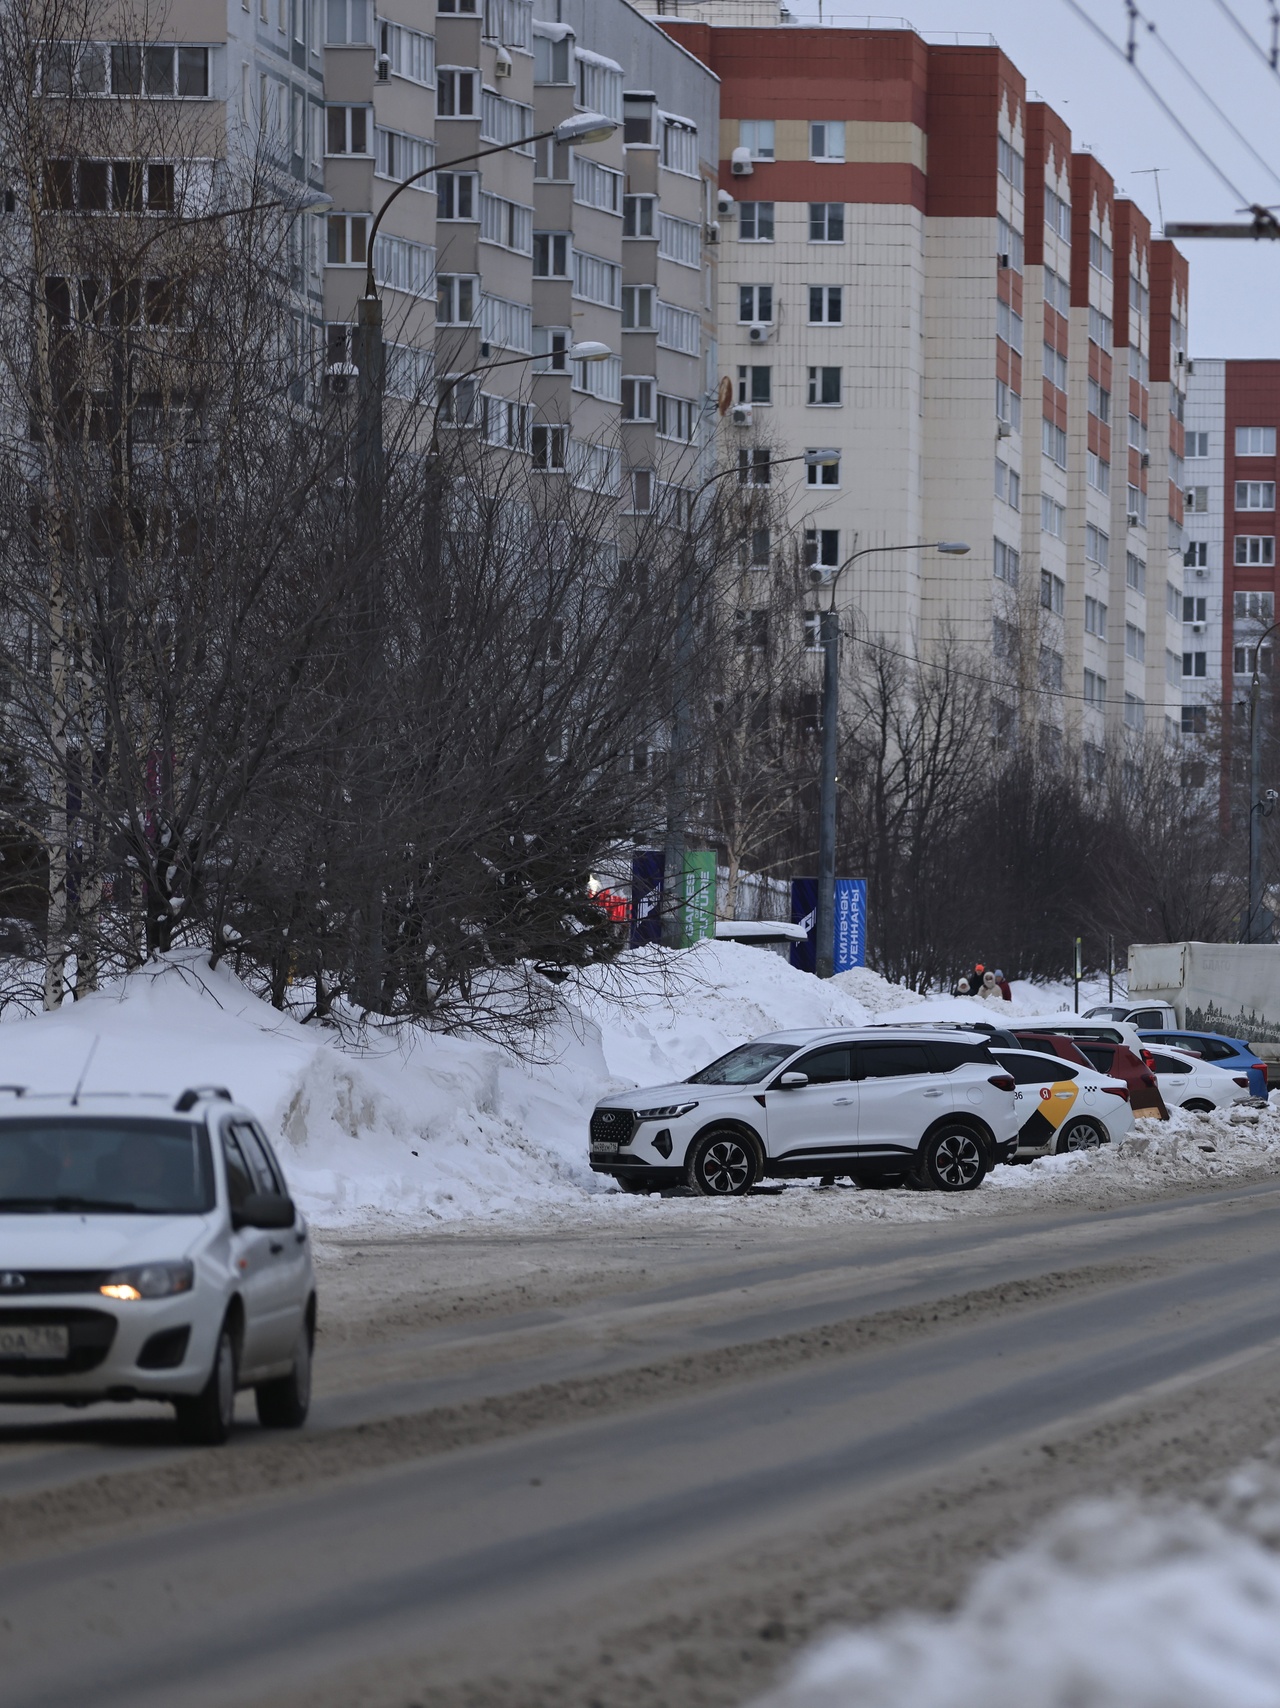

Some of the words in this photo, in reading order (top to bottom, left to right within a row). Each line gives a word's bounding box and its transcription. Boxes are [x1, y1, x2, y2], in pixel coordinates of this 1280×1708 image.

[685, 873, 695, 937] GAMES
[699, 871, 710, 940] FUTURE
[839, 889, 849, 964] КИЛӘЧӘК
